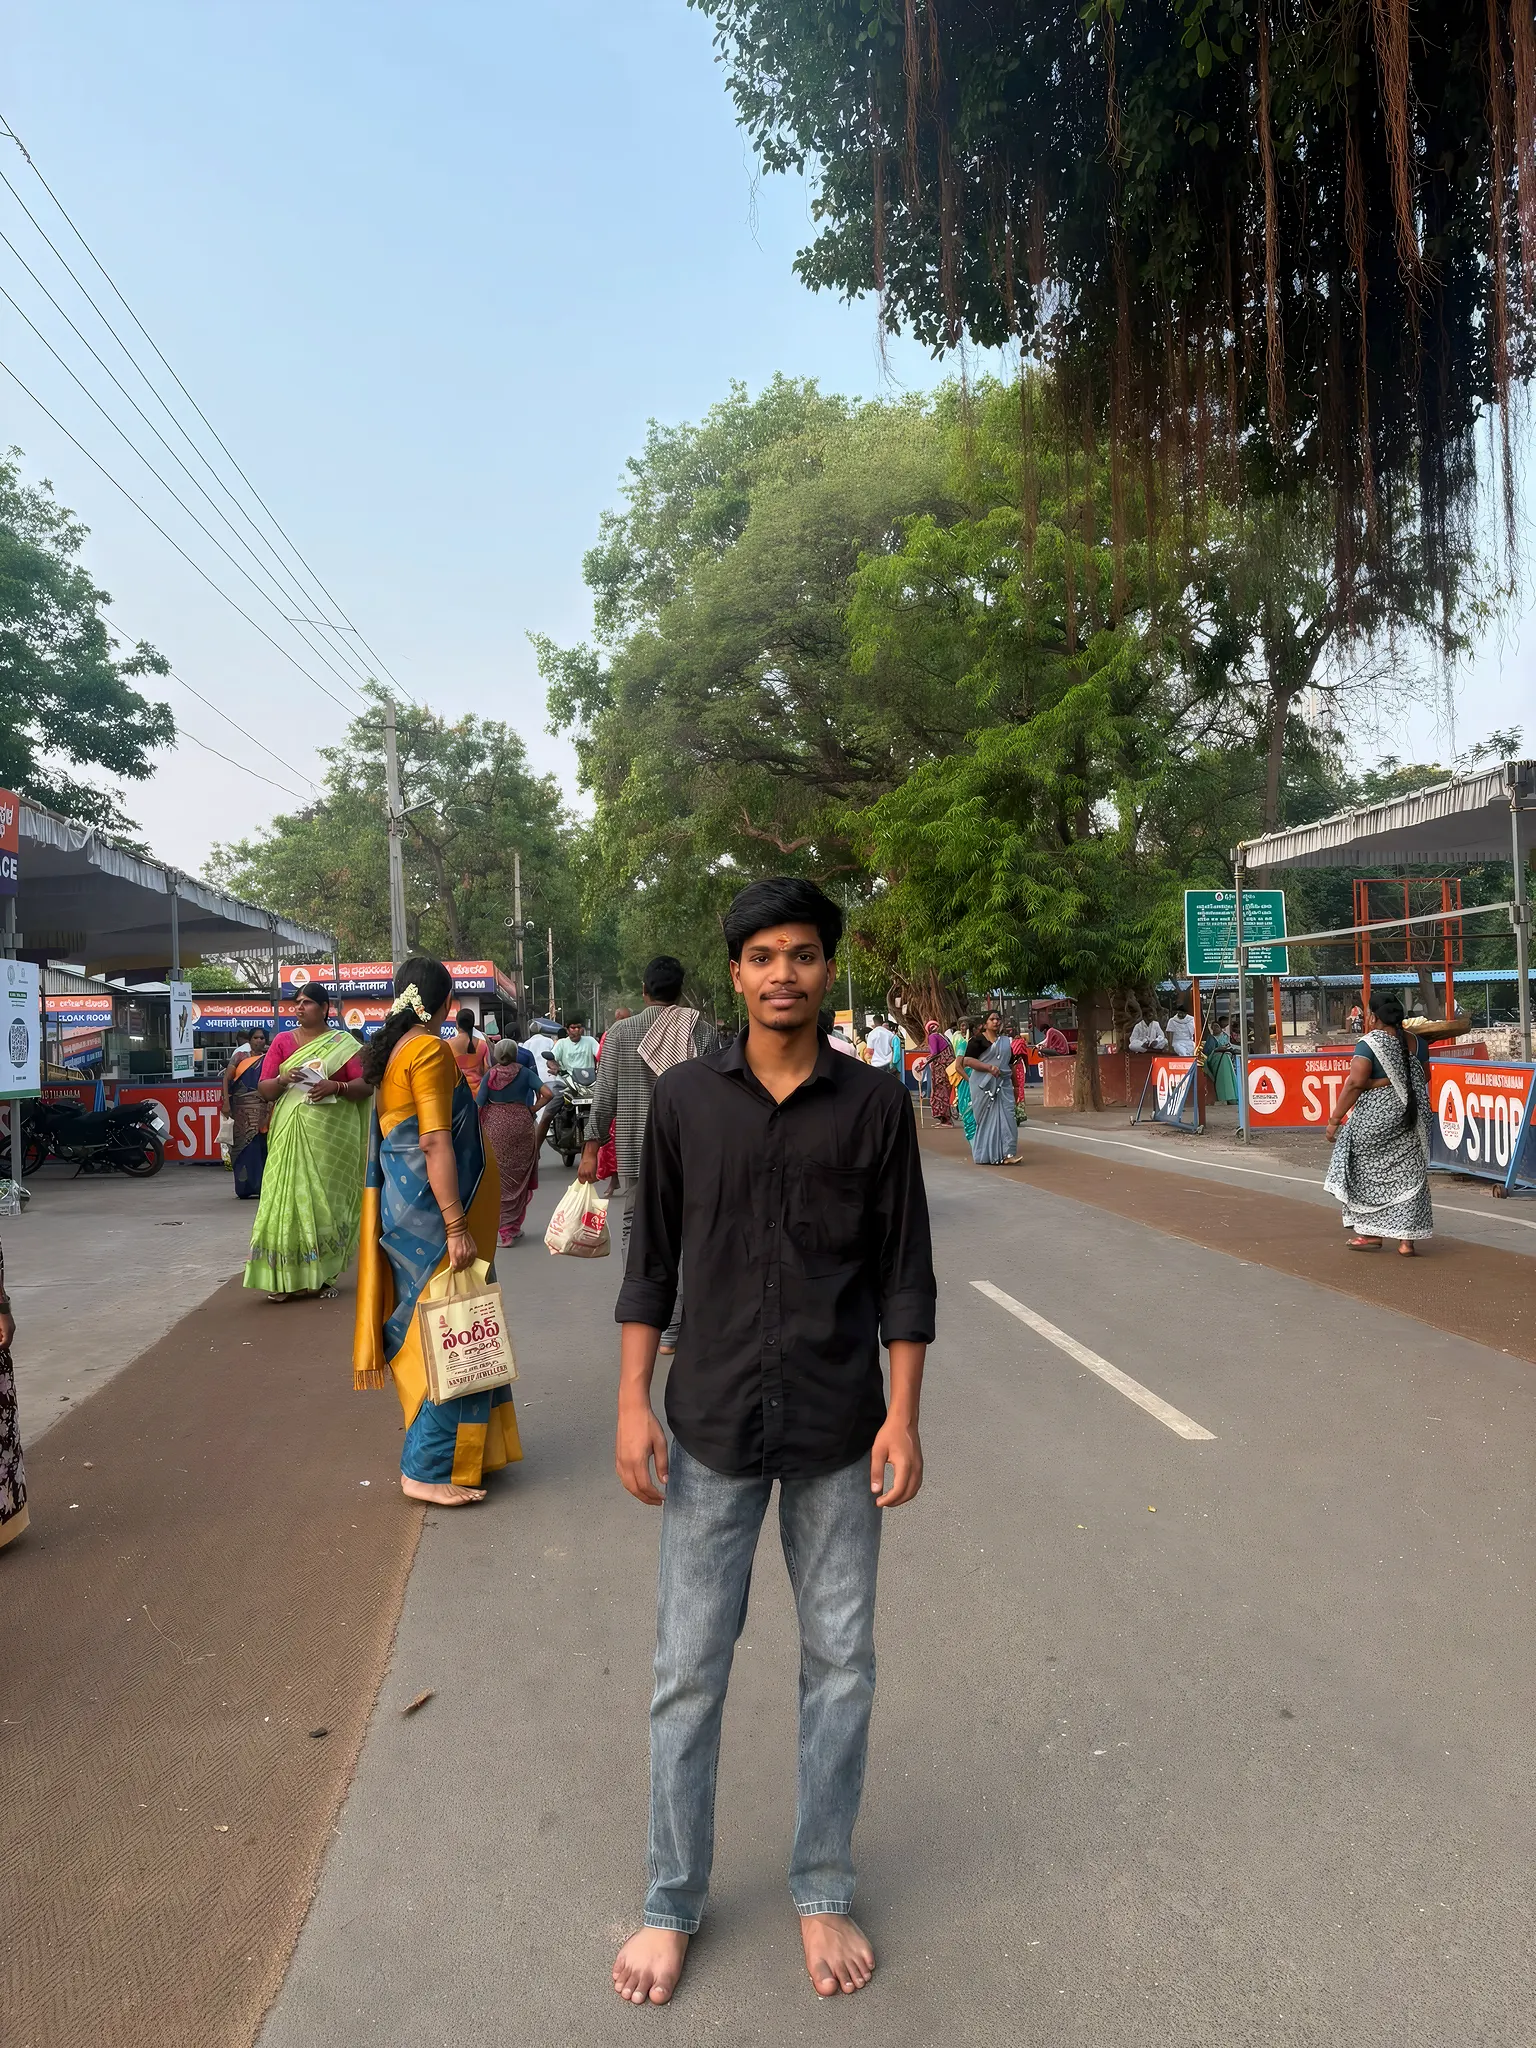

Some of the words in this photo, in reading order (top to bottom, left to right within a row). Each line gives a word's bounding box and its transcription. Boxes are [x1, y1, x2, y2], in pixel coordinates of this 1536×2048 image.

[0, 856, 18, 880] CE
[455, 980, 486, 989] ROOM
[86, 1014, 111, 1022] ROOM
[1302, 1075, 1342, 1121] ST
[177, 1106, 218, 1157] ST
[1466, 1092, 1525, 1167] STOP
